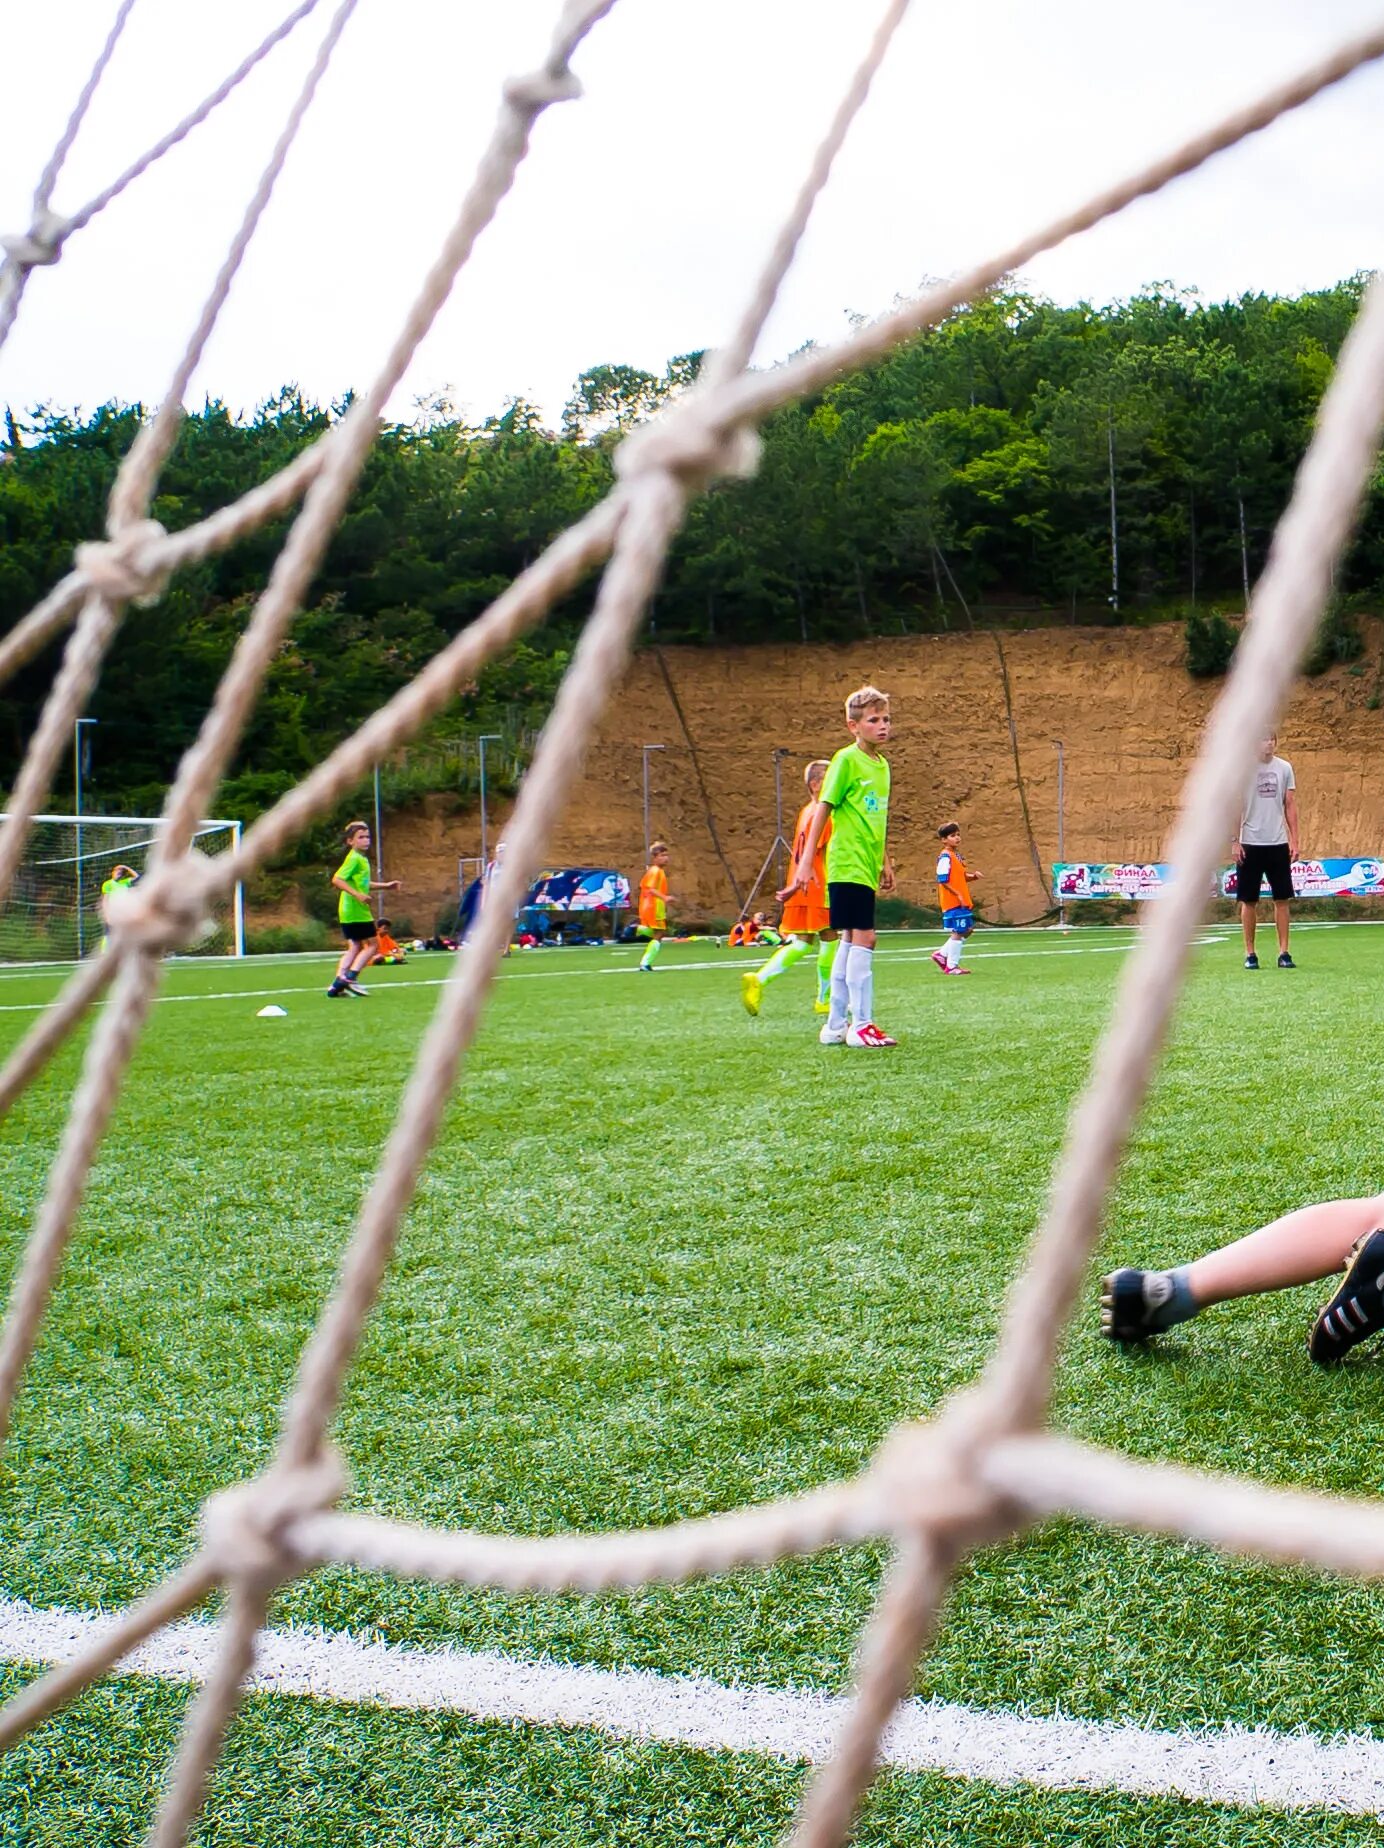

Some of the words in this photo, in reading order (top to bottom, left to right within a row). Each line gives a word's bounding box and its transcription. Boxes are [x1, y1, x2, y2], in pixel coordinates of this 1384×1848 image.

[1113, 868, 1157, 877] ФИНАЛ
[1290, 865, 1323, 874] ИНАЛ
[955, 919, 967, 928] 16
